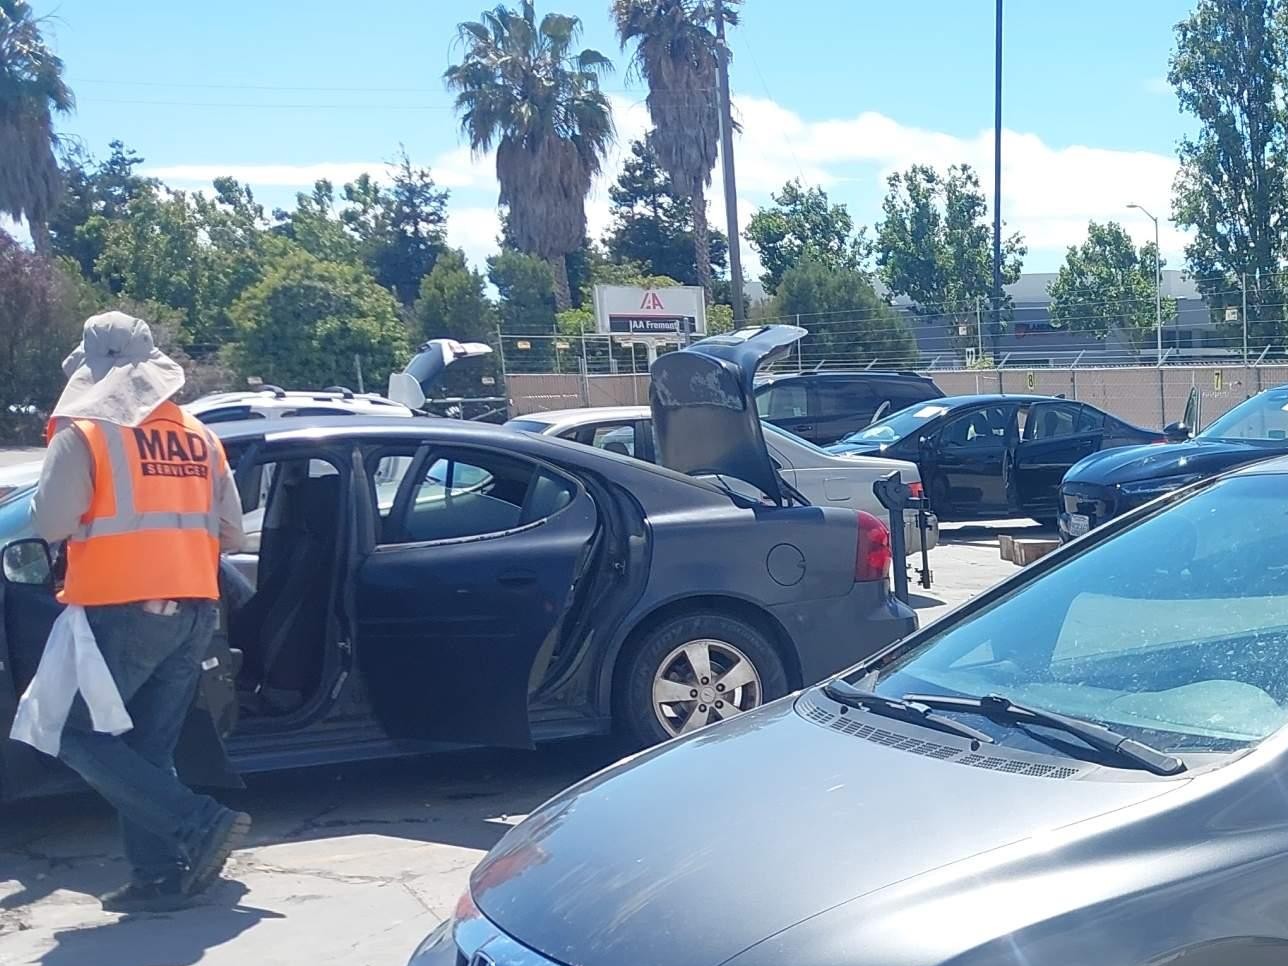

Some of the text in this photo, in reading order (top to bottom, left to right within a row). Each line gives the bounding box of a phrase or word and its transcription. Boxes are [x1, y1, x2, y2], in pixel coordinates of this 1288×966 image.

[1028, 374, 1034, 388] 8
[1214, 372, 1220, 389] 7
[133, 427, 208, 462] MAD
